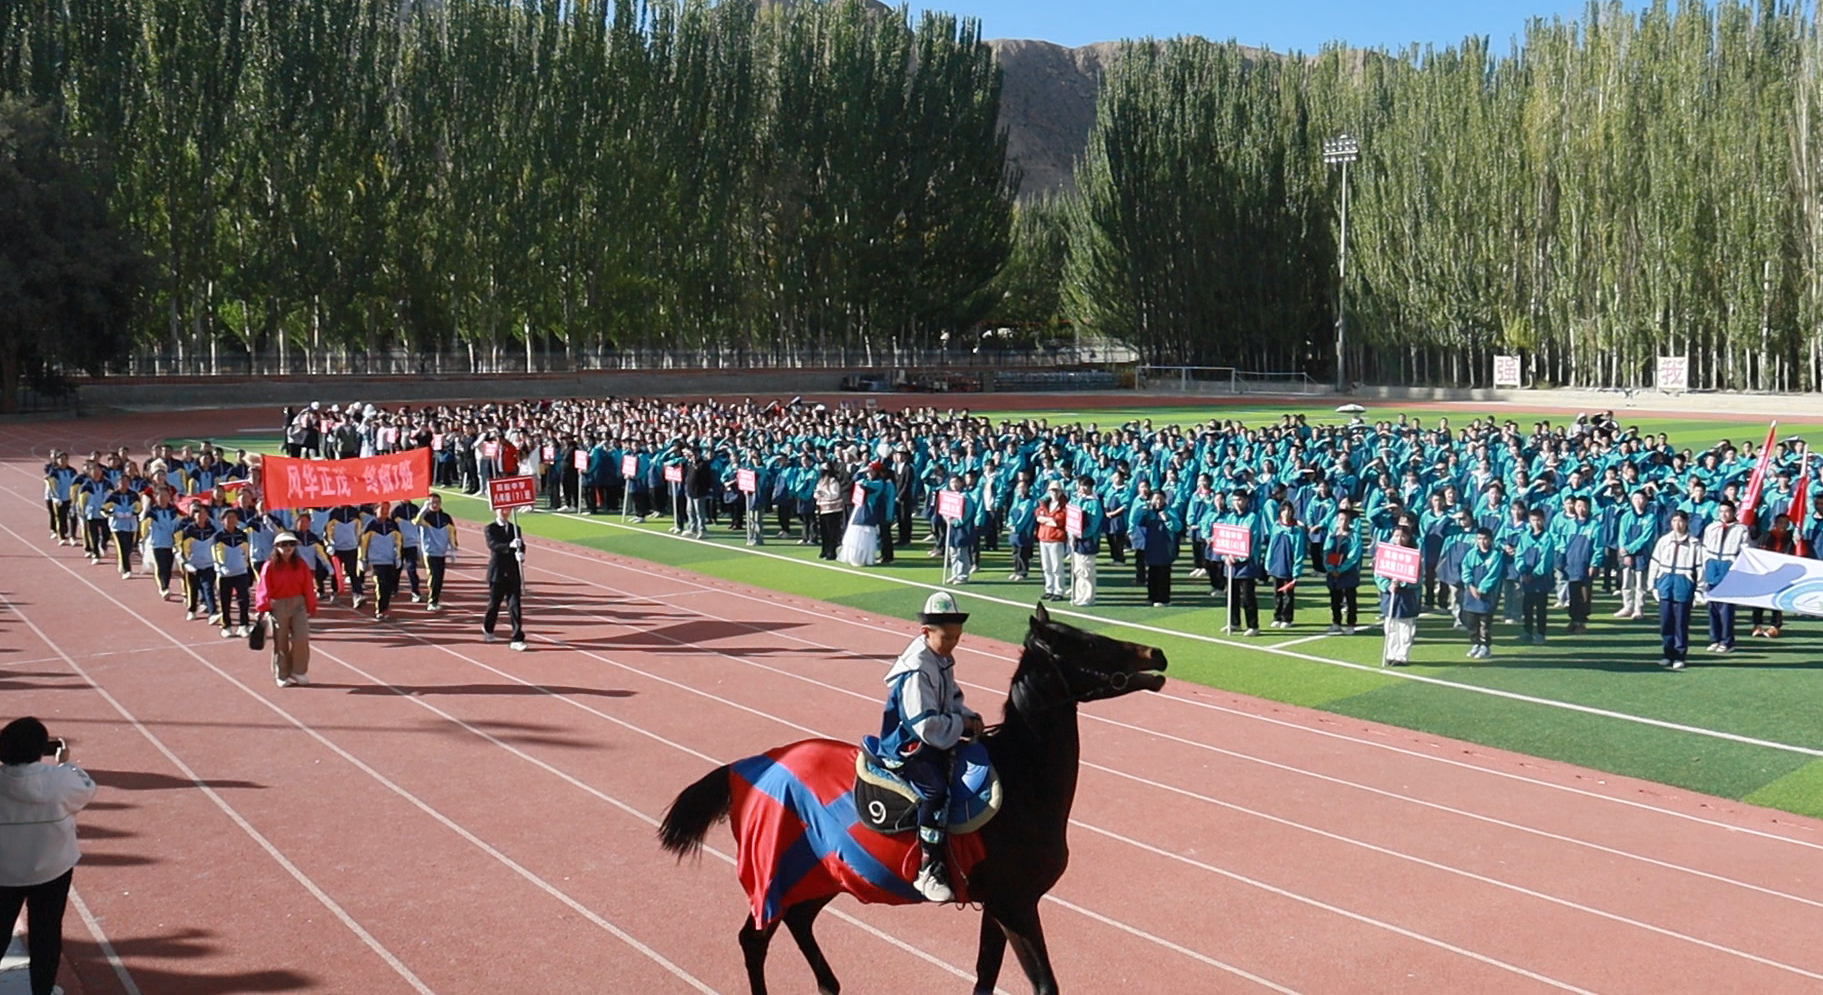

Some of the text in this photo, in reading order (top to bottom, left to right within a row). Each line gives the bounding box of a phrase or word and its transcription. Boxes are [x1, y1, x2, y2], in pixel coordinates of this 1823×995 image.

[1496, 358, 1517, 382] 强
[1661, 358, 1686, 385] 我
[868, 800, 887, 825] 9
